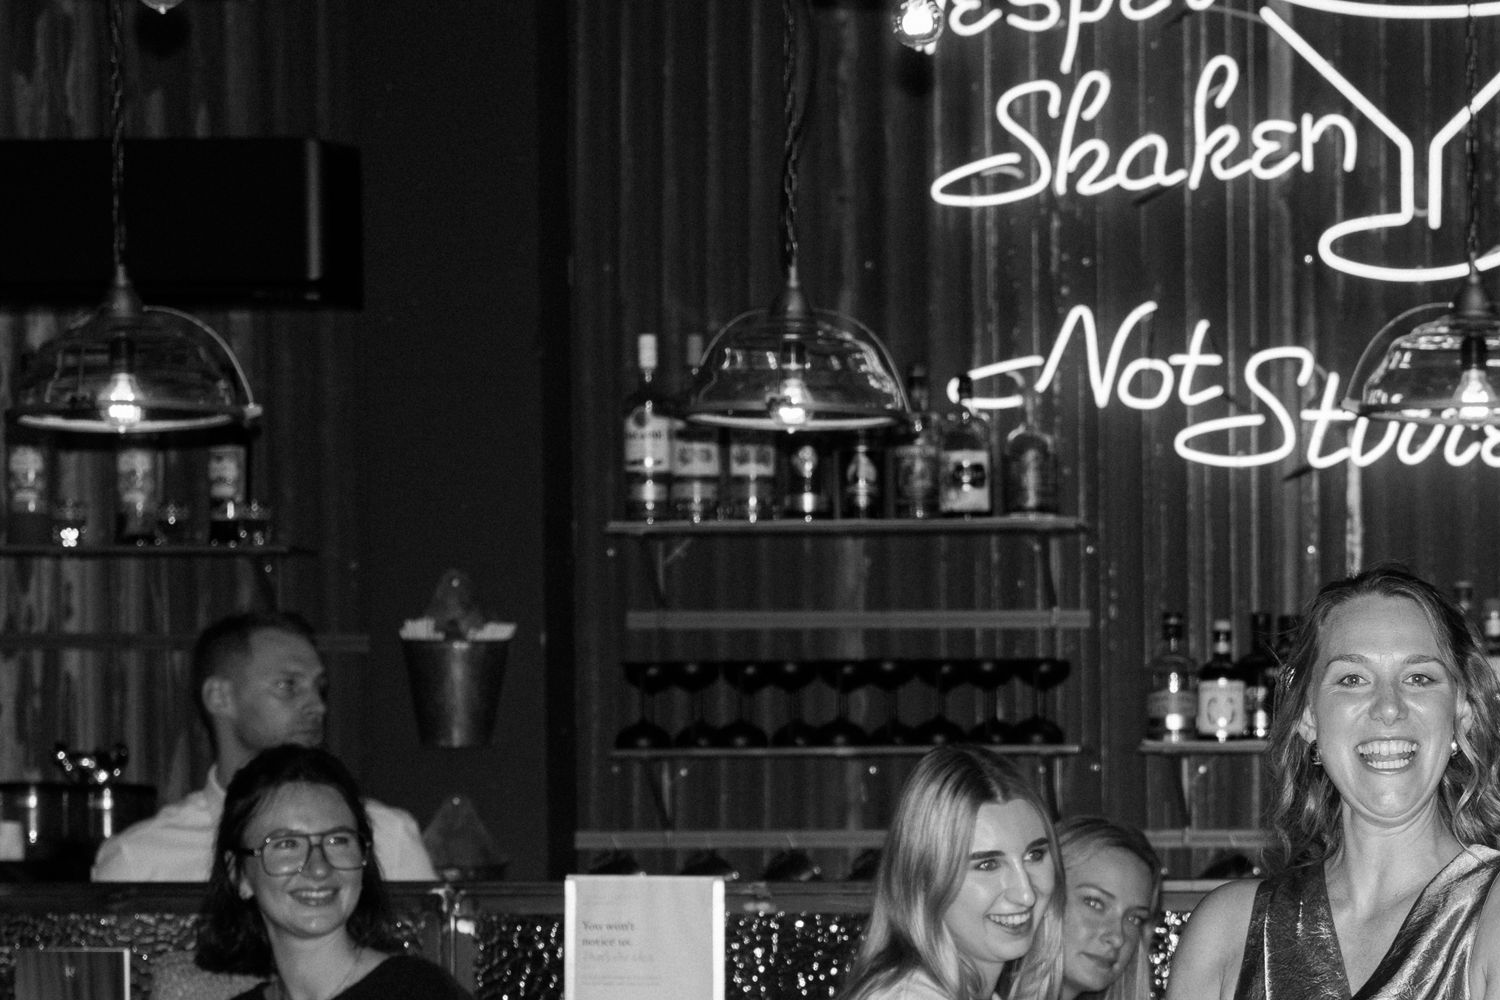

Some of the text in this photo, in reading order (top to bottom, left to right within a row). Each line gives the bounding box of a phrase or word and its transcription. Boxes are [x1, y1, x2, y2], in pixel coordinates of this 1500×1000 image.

[929, 54, 1358, 208] Shaken
[946, 302, 1225, 410] Not
[582, 920, 635, 931] You won't
